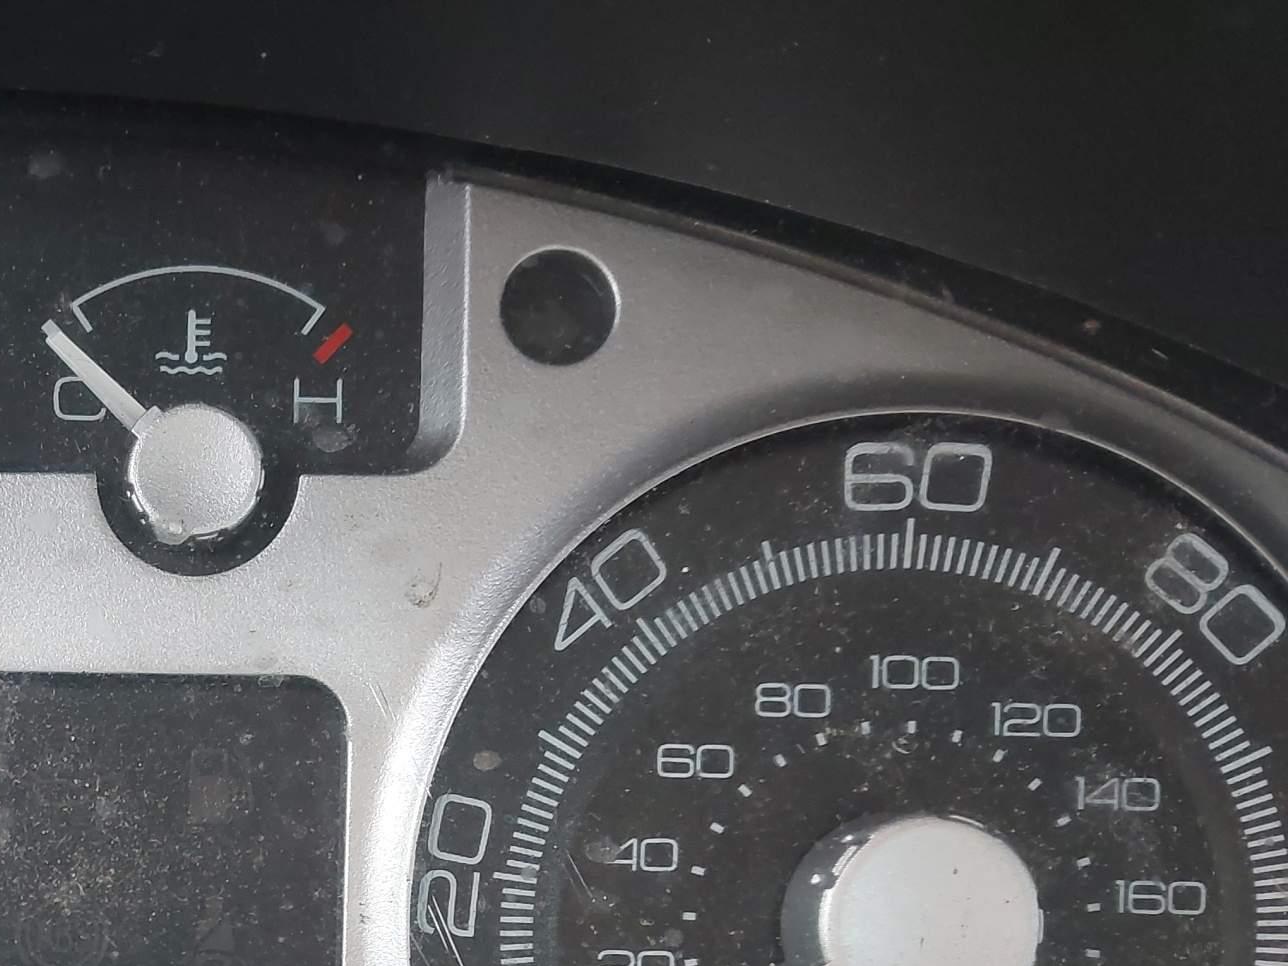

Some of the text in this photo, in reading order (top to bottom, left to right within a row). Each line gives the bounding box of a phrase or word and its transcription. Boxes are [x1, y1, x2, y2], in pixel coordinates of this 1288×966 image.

[53, 376, 107, 421] C
[293, 377, 343, 424] H
[843, 441, 993, 513] 60
[553, 528, 666, 652] 40
[1145, 532, 1286, 666] 80
[868, 654, 961, 691] 100
[754, 682, 832, 719] 80
[992, 701, 1083, 738] 120
[656, 743, 735, 779] 60
[1074, 775, 1161, 812] 140
[416, 793, 493, 938] 20
[606, 837, 679, 873] 40
[1115, 879, 1207, 916] 160
